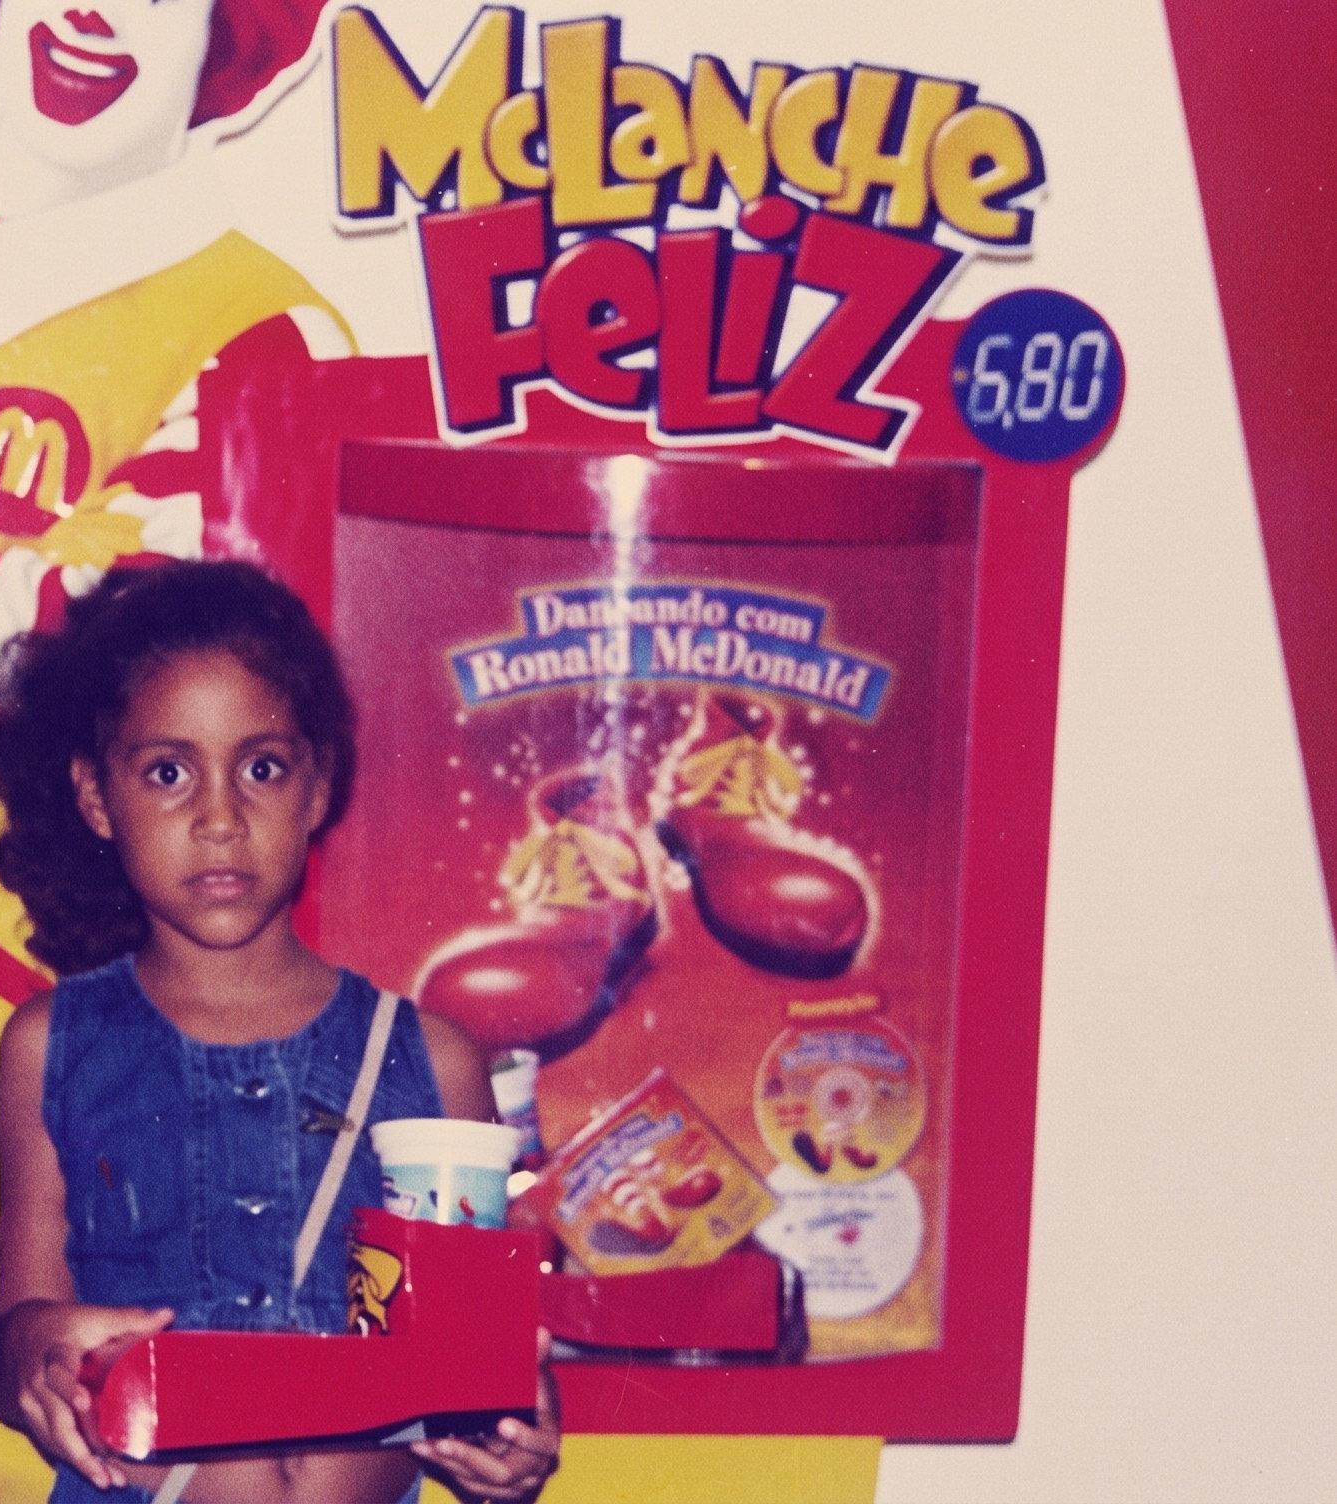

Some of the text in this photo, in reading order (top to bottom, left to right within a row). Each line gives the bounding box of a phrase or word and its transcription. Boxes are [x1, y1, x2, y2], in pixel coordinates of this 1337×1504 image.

[966, 330, 1109, 431] 6,80
[533, 588, 814, 643] Danando com
[468, 626, 869, 708] Ronald McDonald
